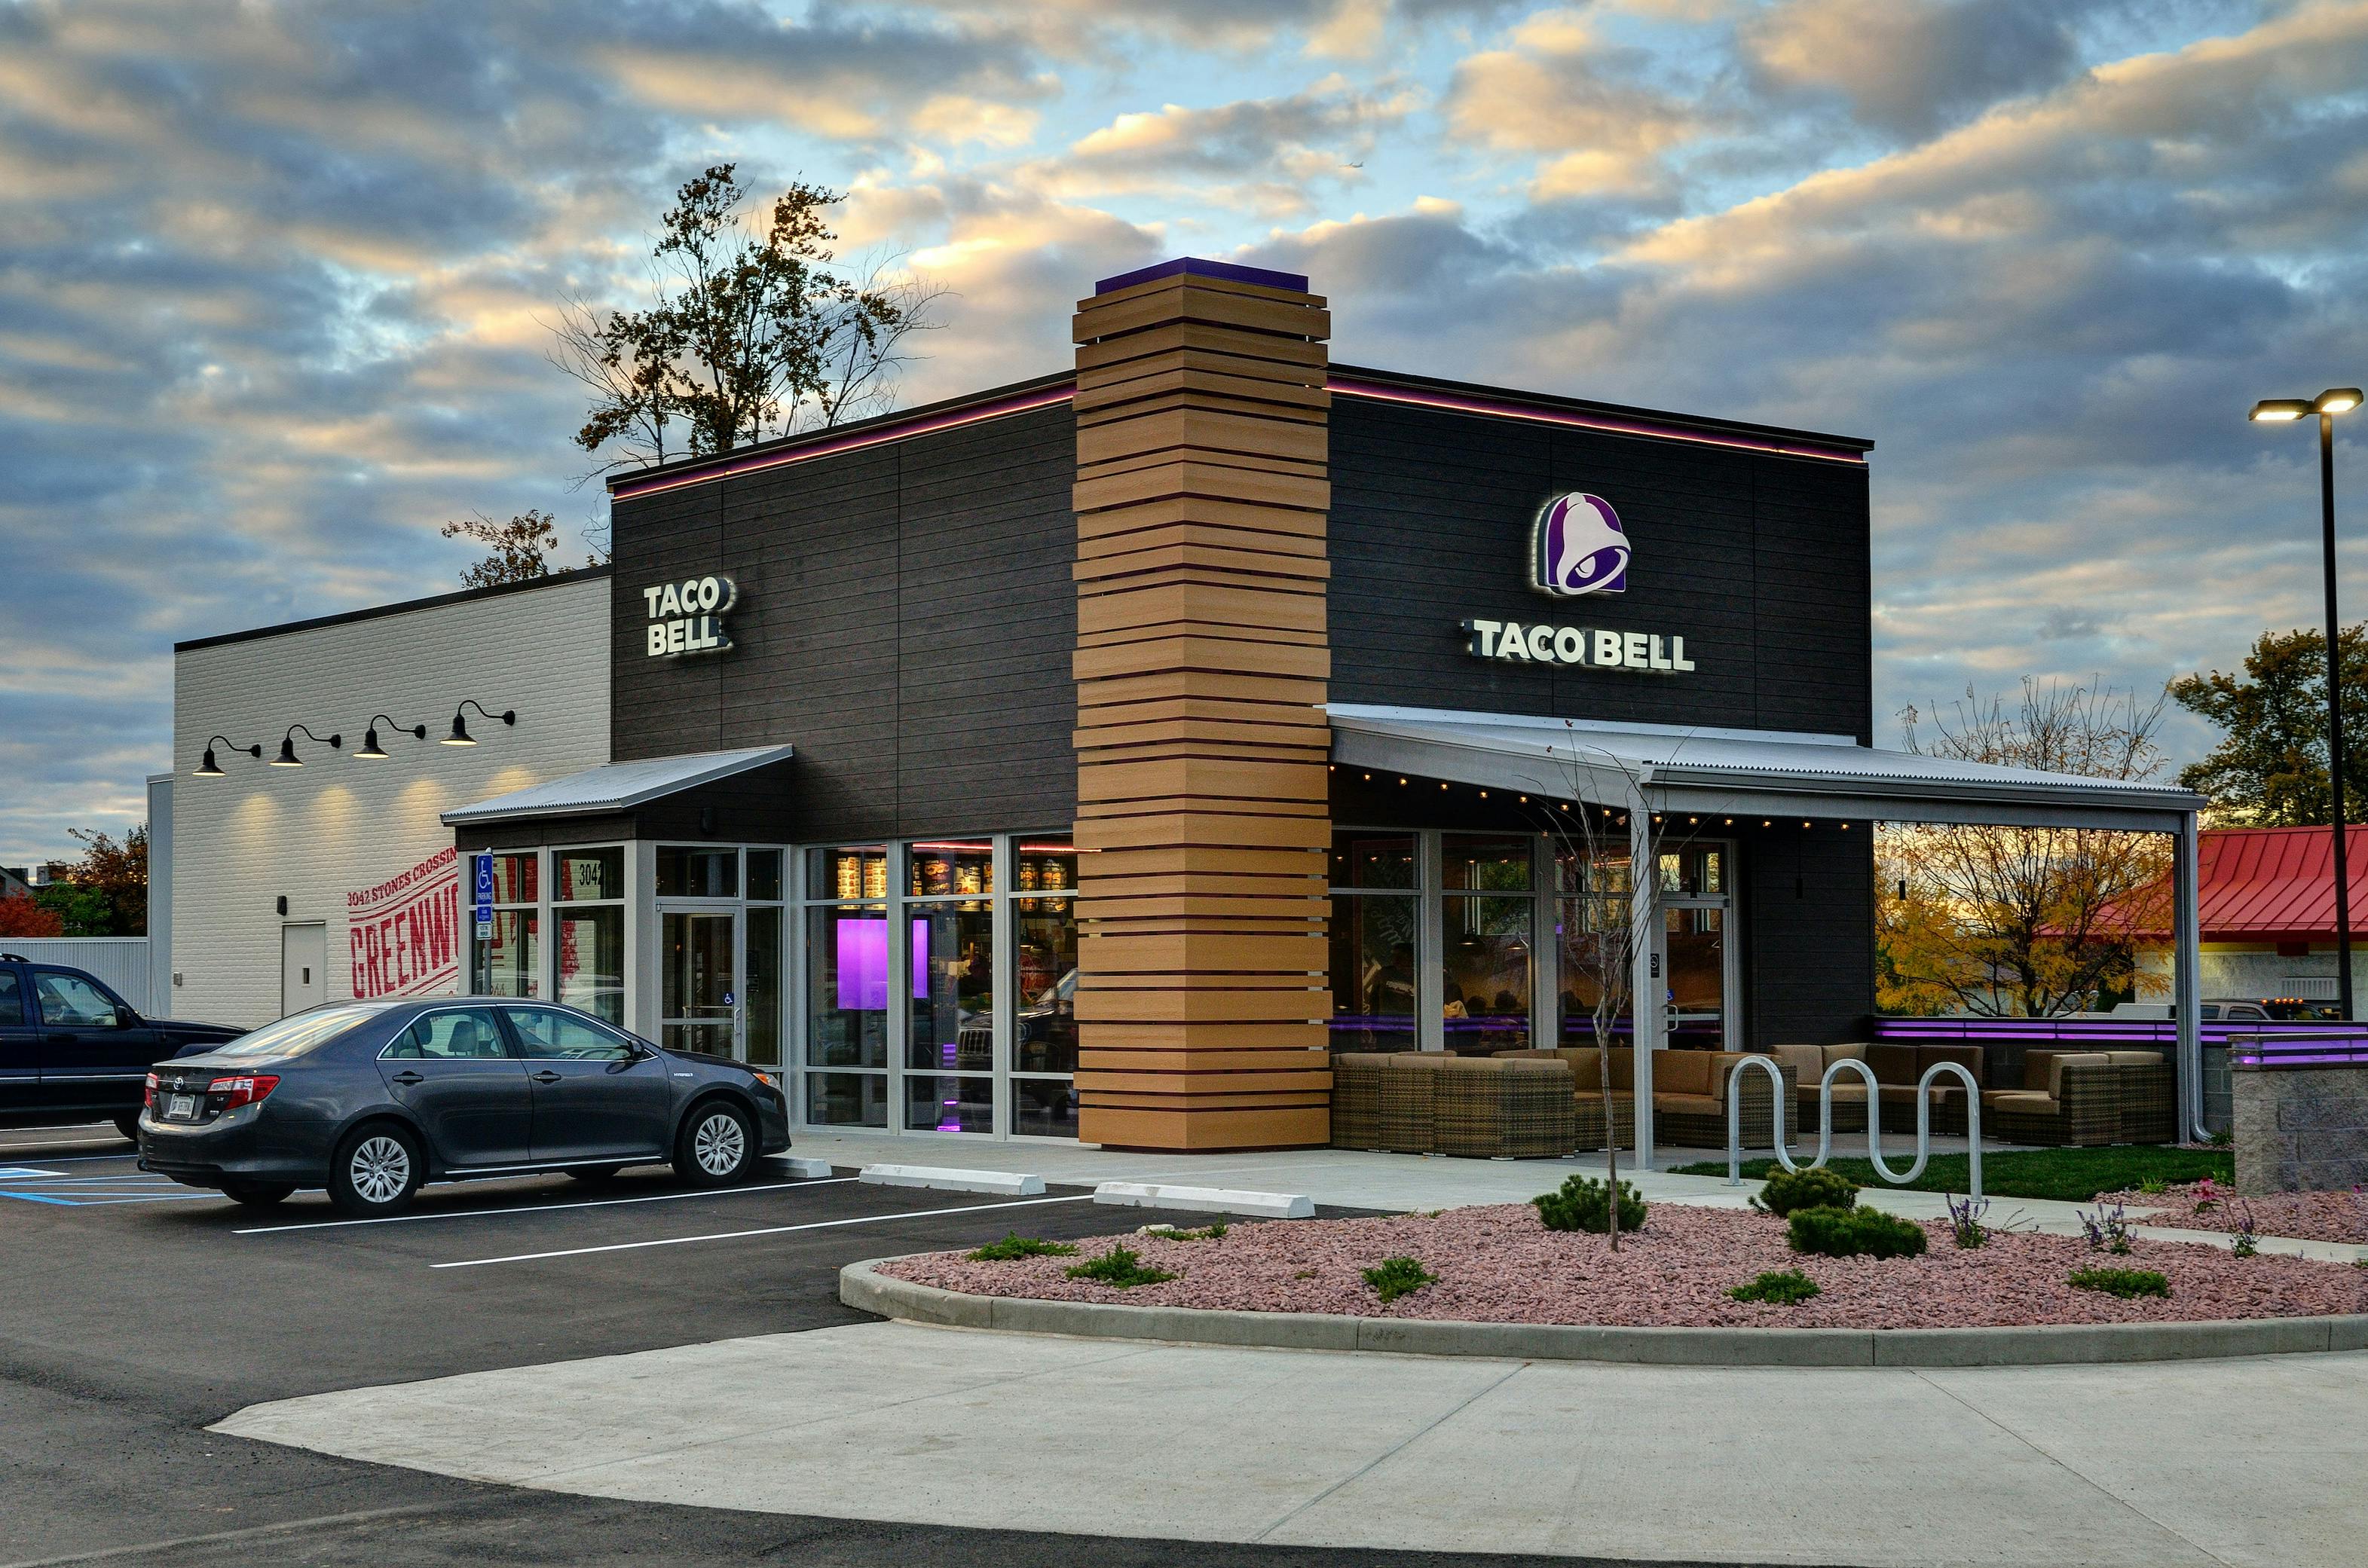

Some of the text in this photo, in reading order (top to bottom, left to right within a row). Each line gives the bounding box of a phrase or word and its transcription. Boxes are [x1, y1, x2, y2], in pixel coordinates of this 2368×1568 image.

[644, 576, 720, 619] TACO
[648, 616, 717, 656] BELL
[1473, 619, 1695, 671] TACO BELL
[347, 845, 457, 906] 3042 STONES CROSSIN
